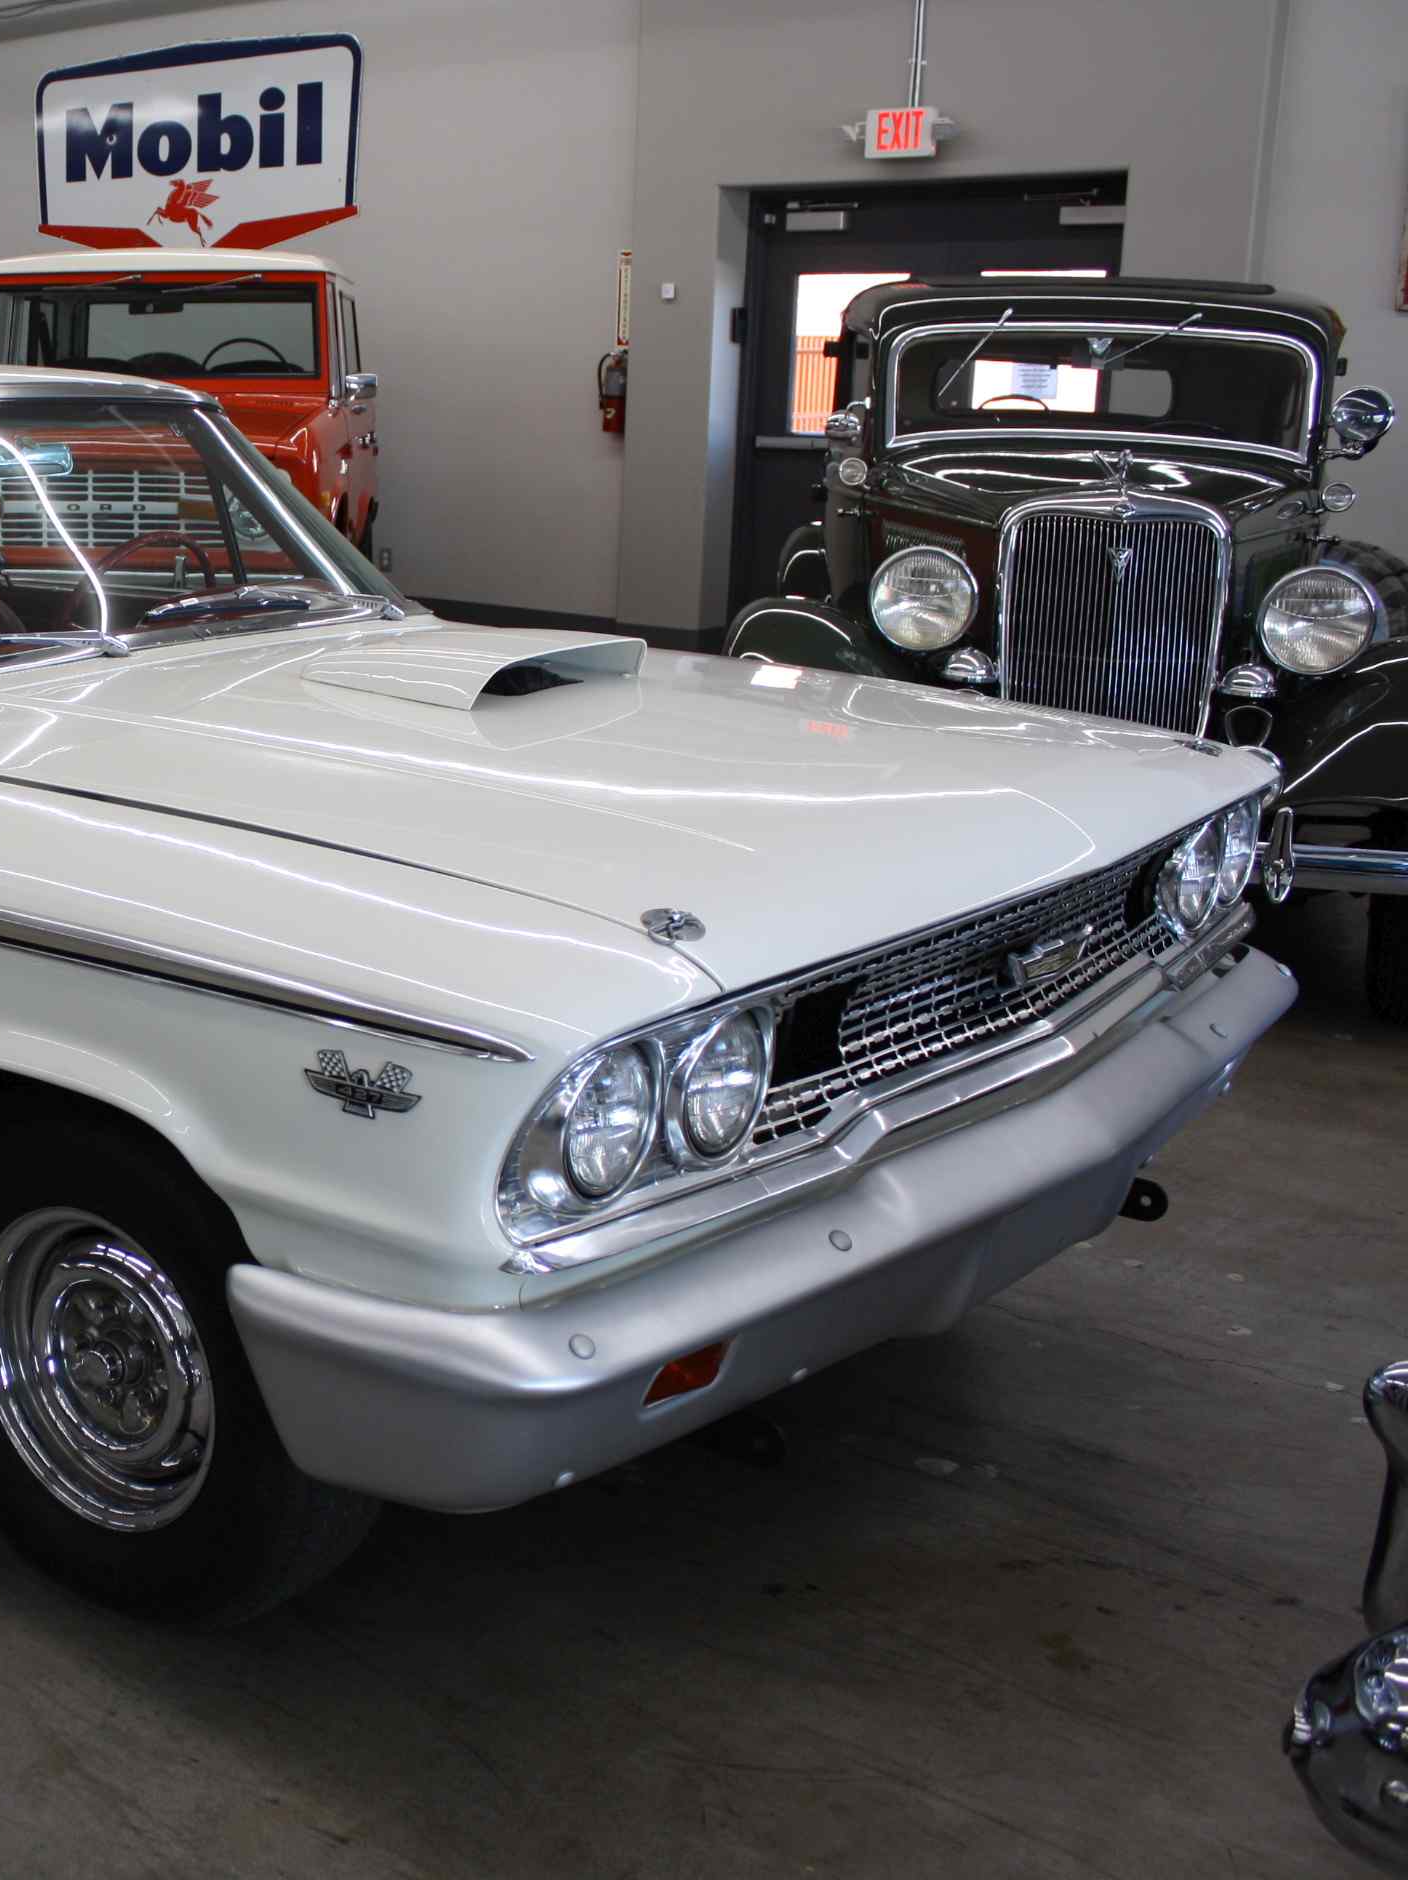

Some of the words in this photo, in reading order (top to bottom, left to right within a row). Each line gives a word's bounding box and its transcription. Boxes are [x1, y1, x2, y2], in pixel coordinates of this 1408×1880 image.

[66, 81, 323, 183] Mobil
[877, 109, 925, 151] EXIT
[335, 1084, 384, 1105] 427
